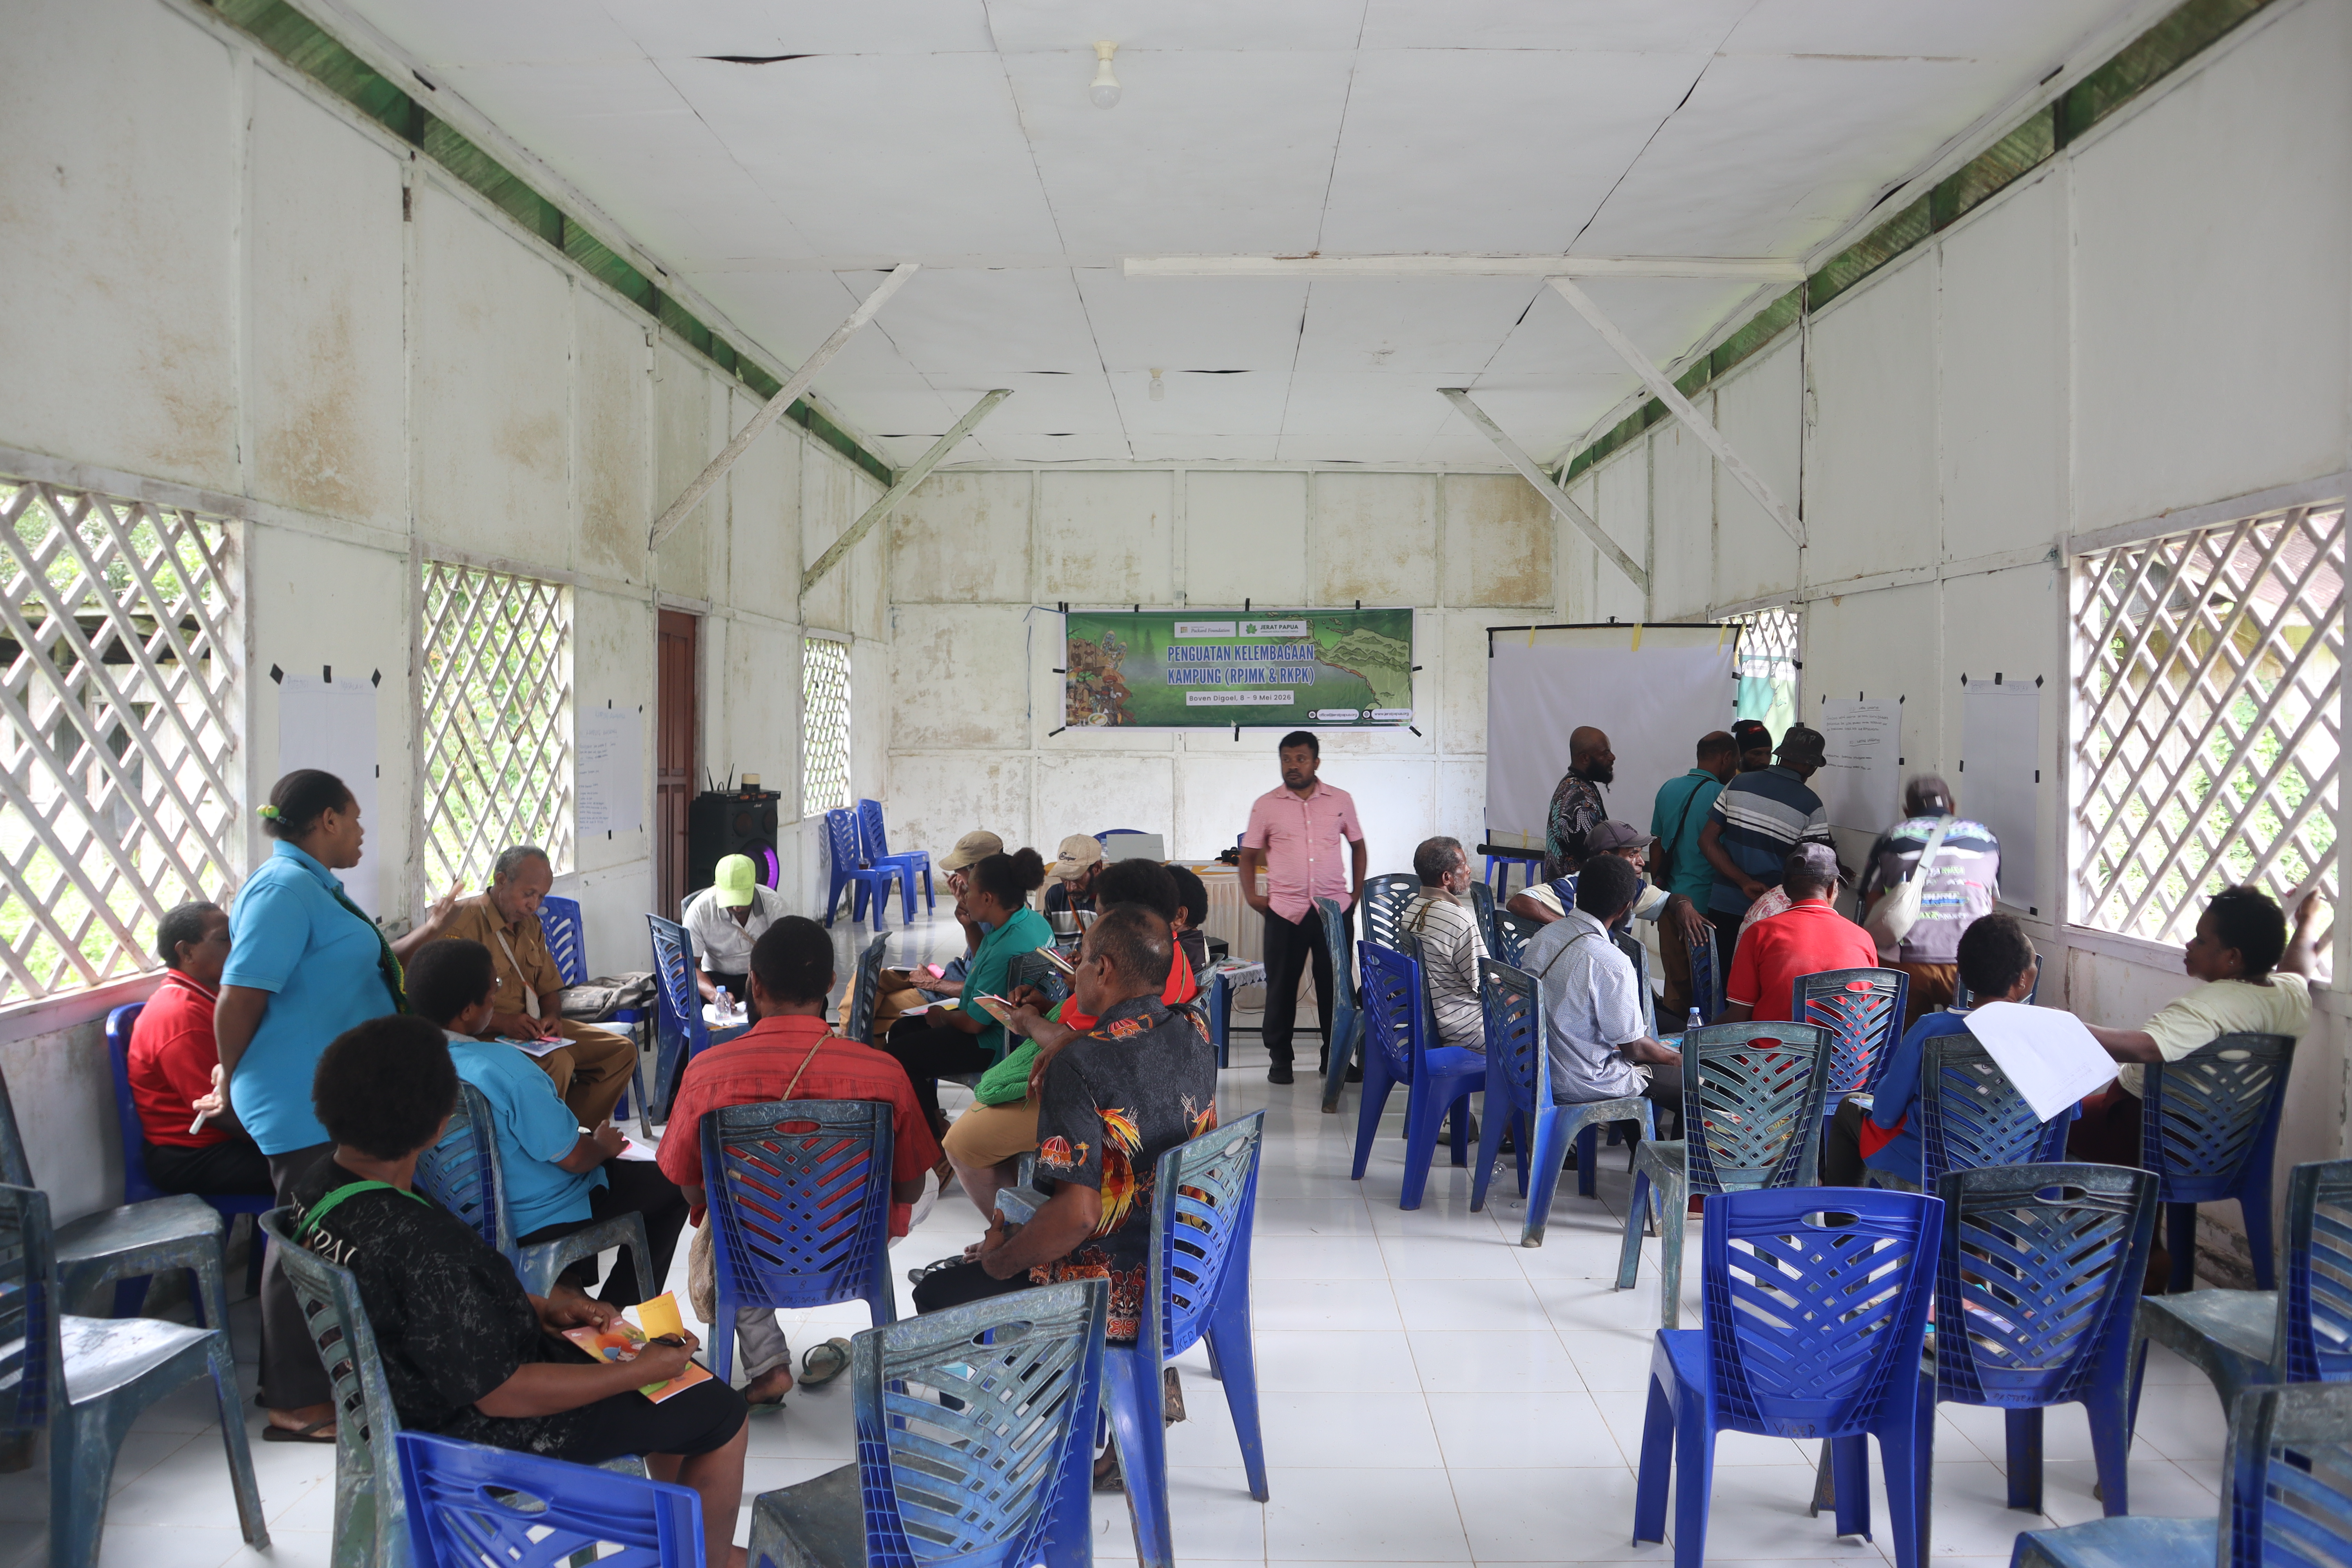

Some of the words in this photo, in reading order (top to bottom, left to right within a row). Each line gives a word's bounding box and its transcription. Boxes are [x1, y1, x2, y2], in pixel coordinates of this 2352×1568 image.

[1168, 646, 1231, 662] PENGUATAN
[1234, 644, 1314, 661] KELEMBAGAAN
[1168, 668, 1221, 684] KAMPUNG
[1225, 667, 1266, 686] (RPJMK
[1269, 668, 1277, 684] &
[1280, 666, 1314, 686] RKPK)
[799, 1280, 806, 1289] 8
[1174, 1330, 1194, 1355] IKEP
